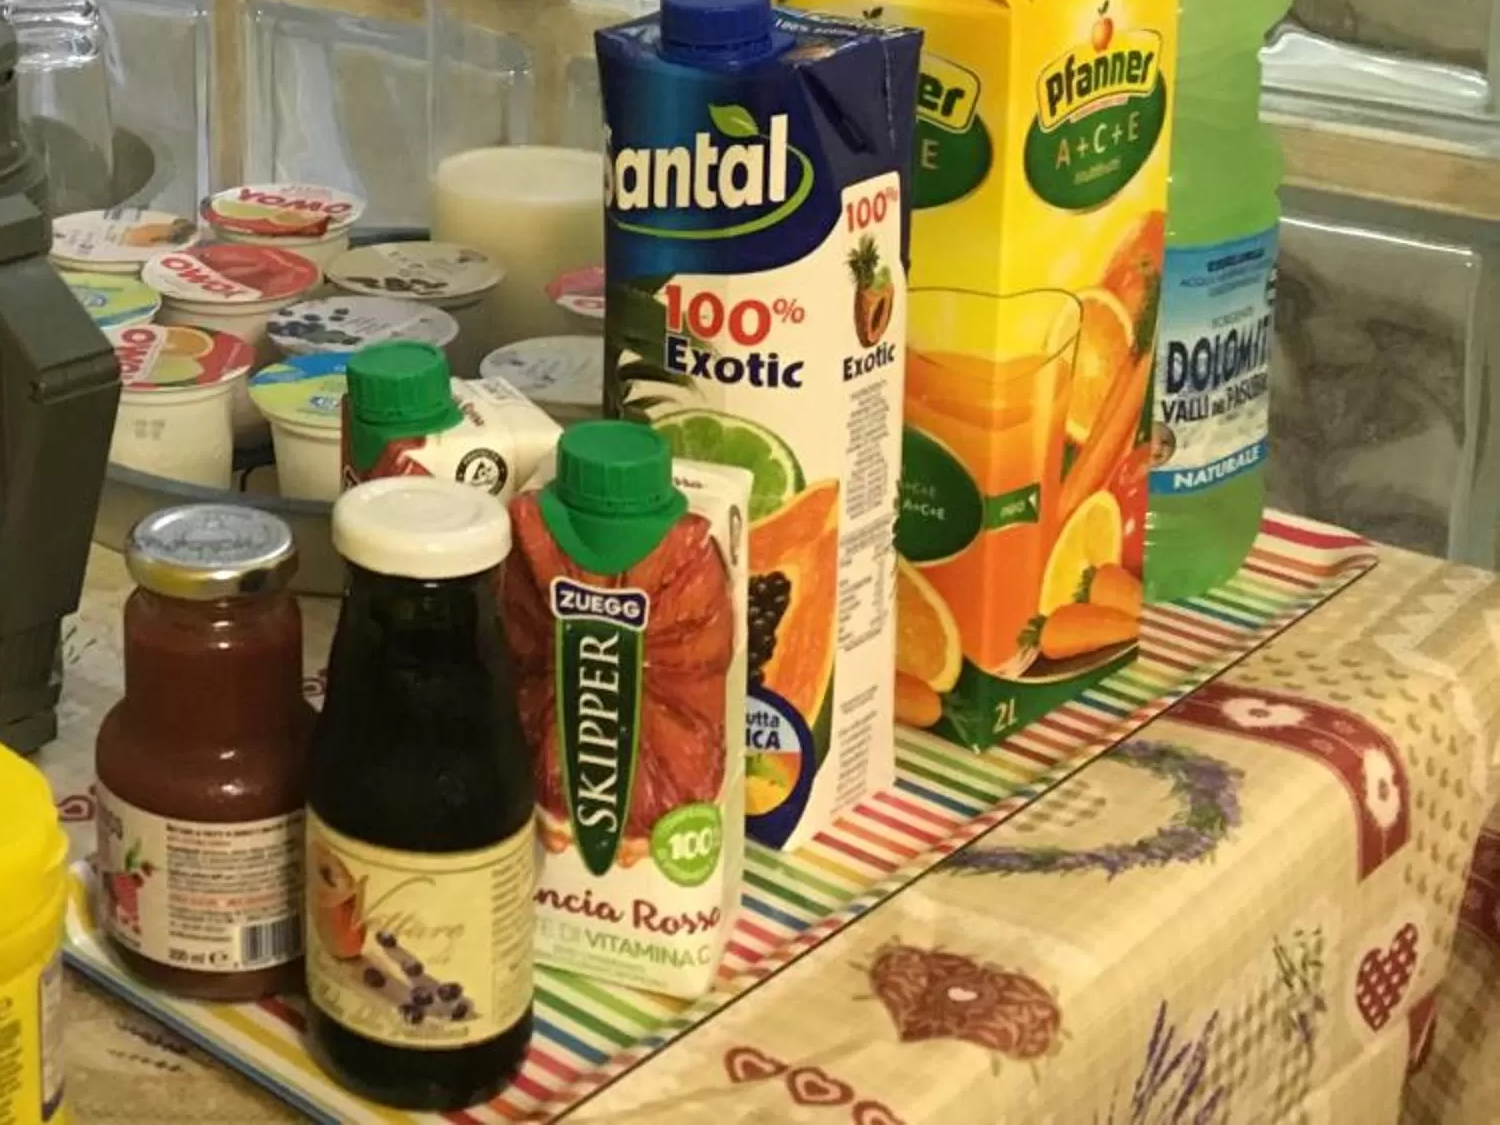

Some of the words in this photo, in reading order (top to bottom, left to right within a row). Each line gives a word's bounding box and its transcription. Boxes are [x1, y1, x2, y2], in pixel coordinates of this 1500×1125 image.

[239, 188, 353, 214] YOMO
[666, 284, 806, 346] 100%
[667, 336, 805, 389] Exotic
[843, 341, 896, 382] Exotic
[1173, 442, 1261, 490] NATURALE
[559, 588, 641, 620] ZUEGG
[577, 632, 621, 834] SKIPPER
[585, 927, 694, 969] VITAMINA
